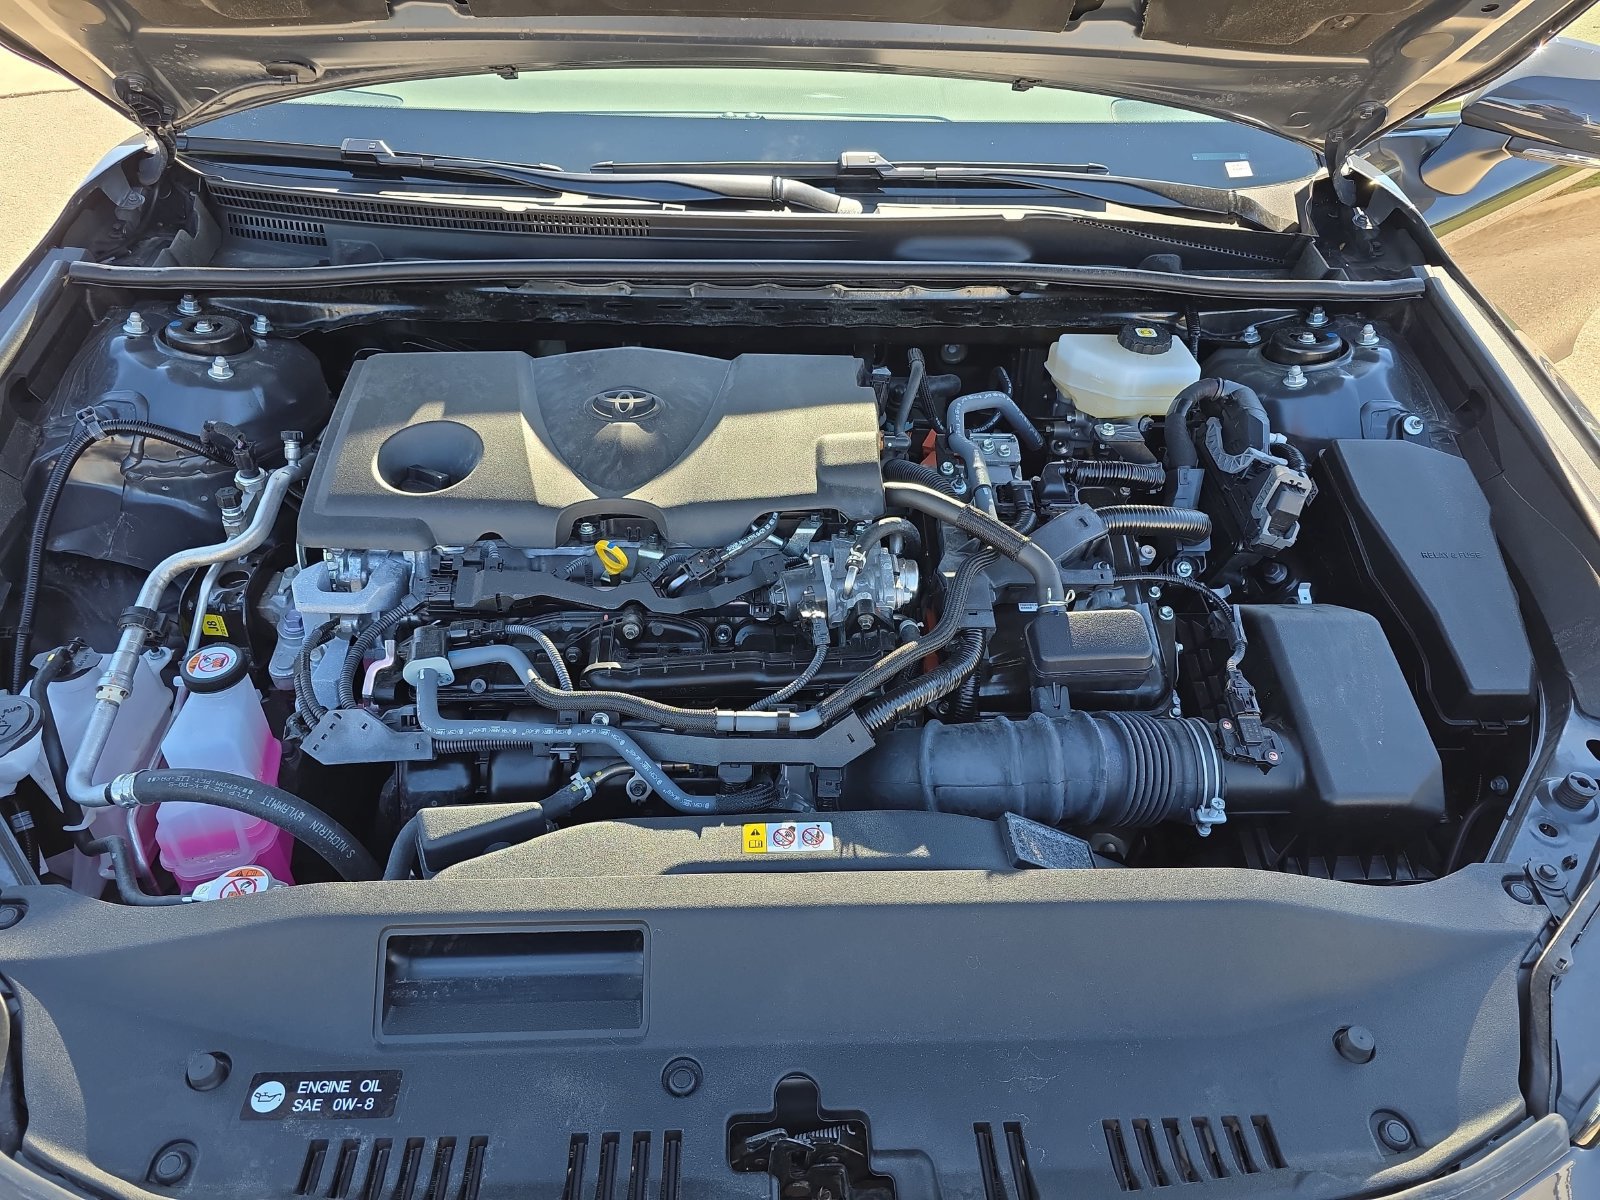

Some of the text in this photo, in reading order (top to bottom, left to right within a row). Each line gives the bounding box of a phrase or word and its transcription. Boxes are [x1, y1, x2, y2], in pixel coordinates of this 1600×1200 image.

[1420, 551, 1449, 559] RELAY
[1458, 551, 1482, 559] FUSE
[297, 1079, 382, 1094] ENGINE OIL
[292, 1097, 375, 1112] SAE 0W-8
